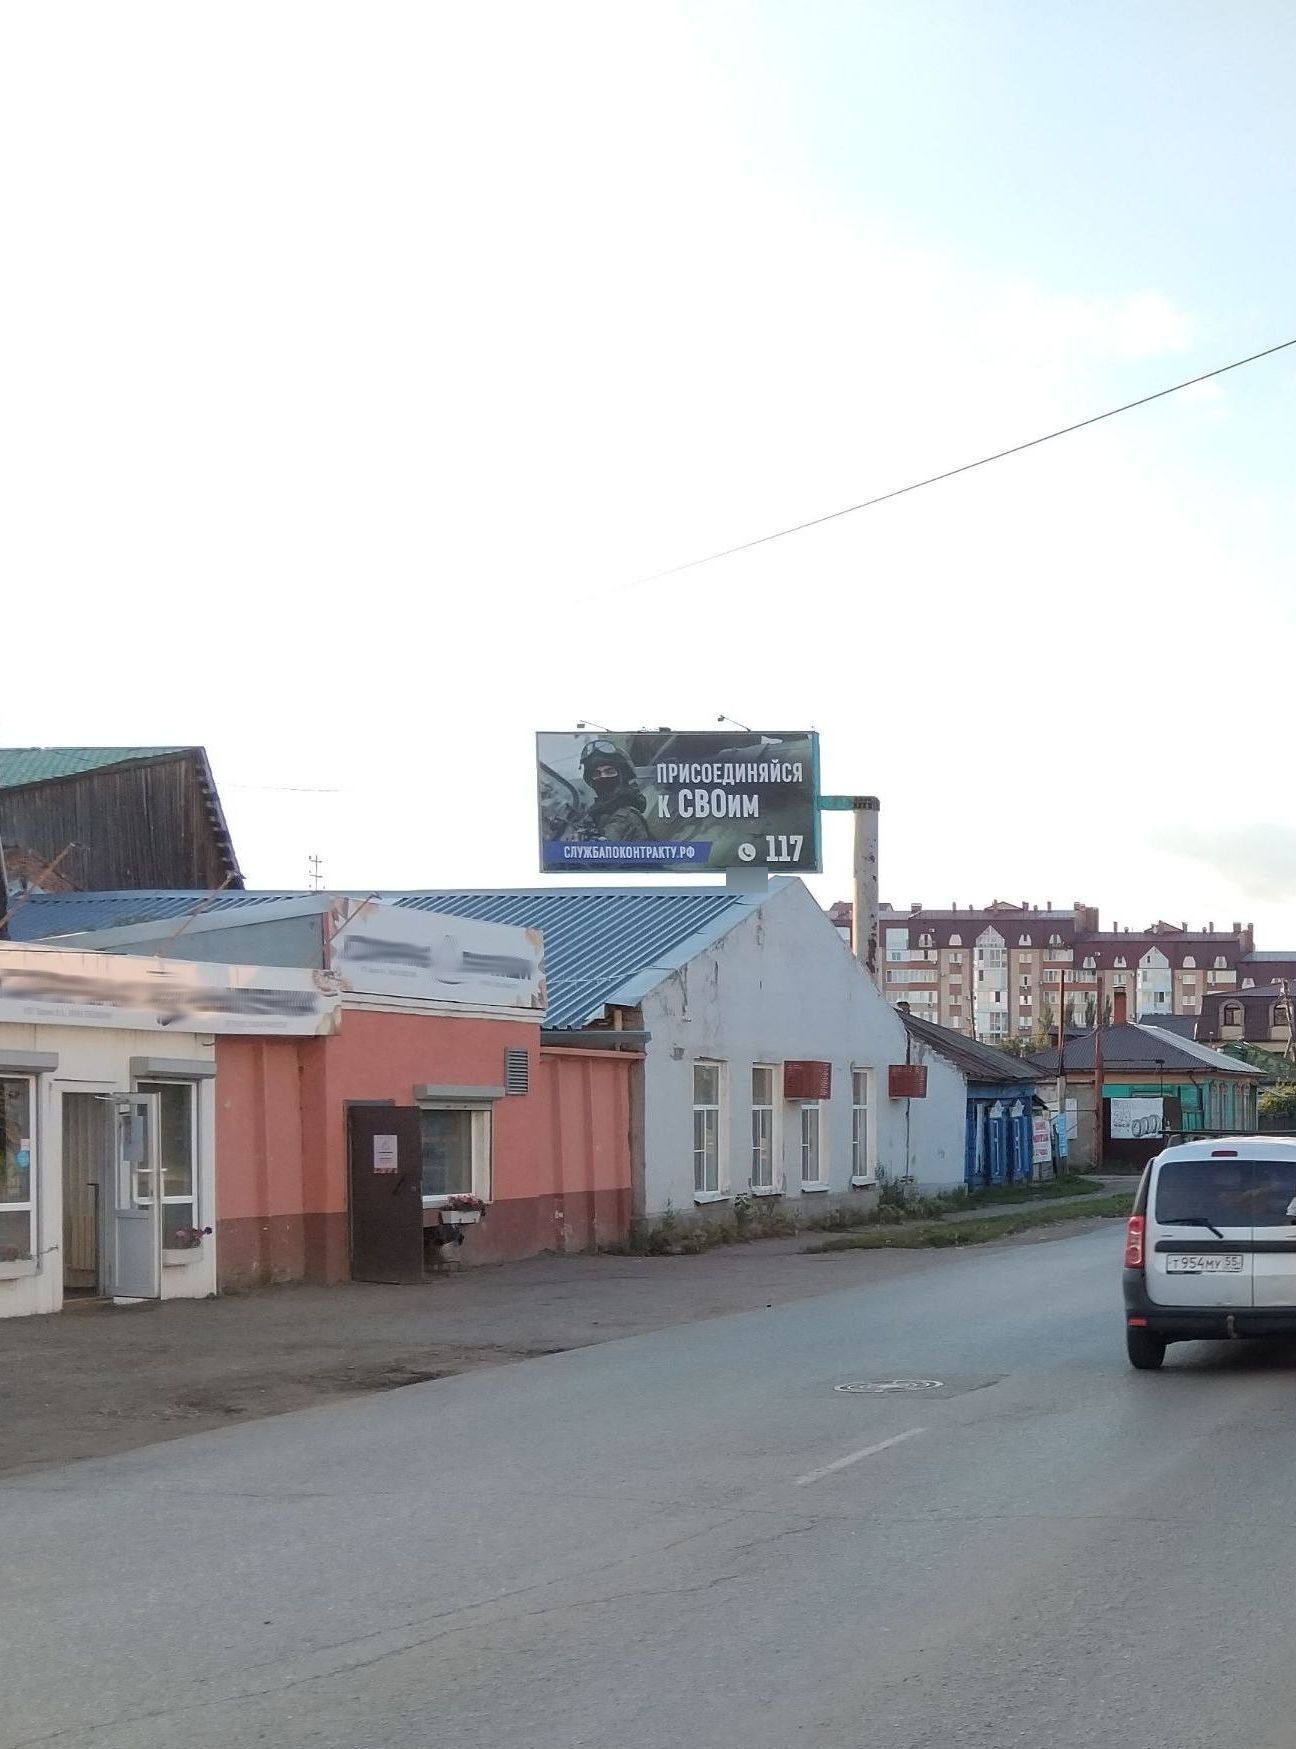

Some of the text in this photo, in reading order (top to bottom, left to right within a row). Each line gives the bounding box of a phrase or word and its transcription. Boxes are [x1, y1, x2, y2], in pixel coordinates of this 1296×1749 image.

[657, 759, 803, 786] ПРИСОЕДИНЯЙСЯ
[564, 845, 695, 860] СЛУЖБАПОКОНТРАКТУ.РФ
[765, 835, 804, 862] 117
